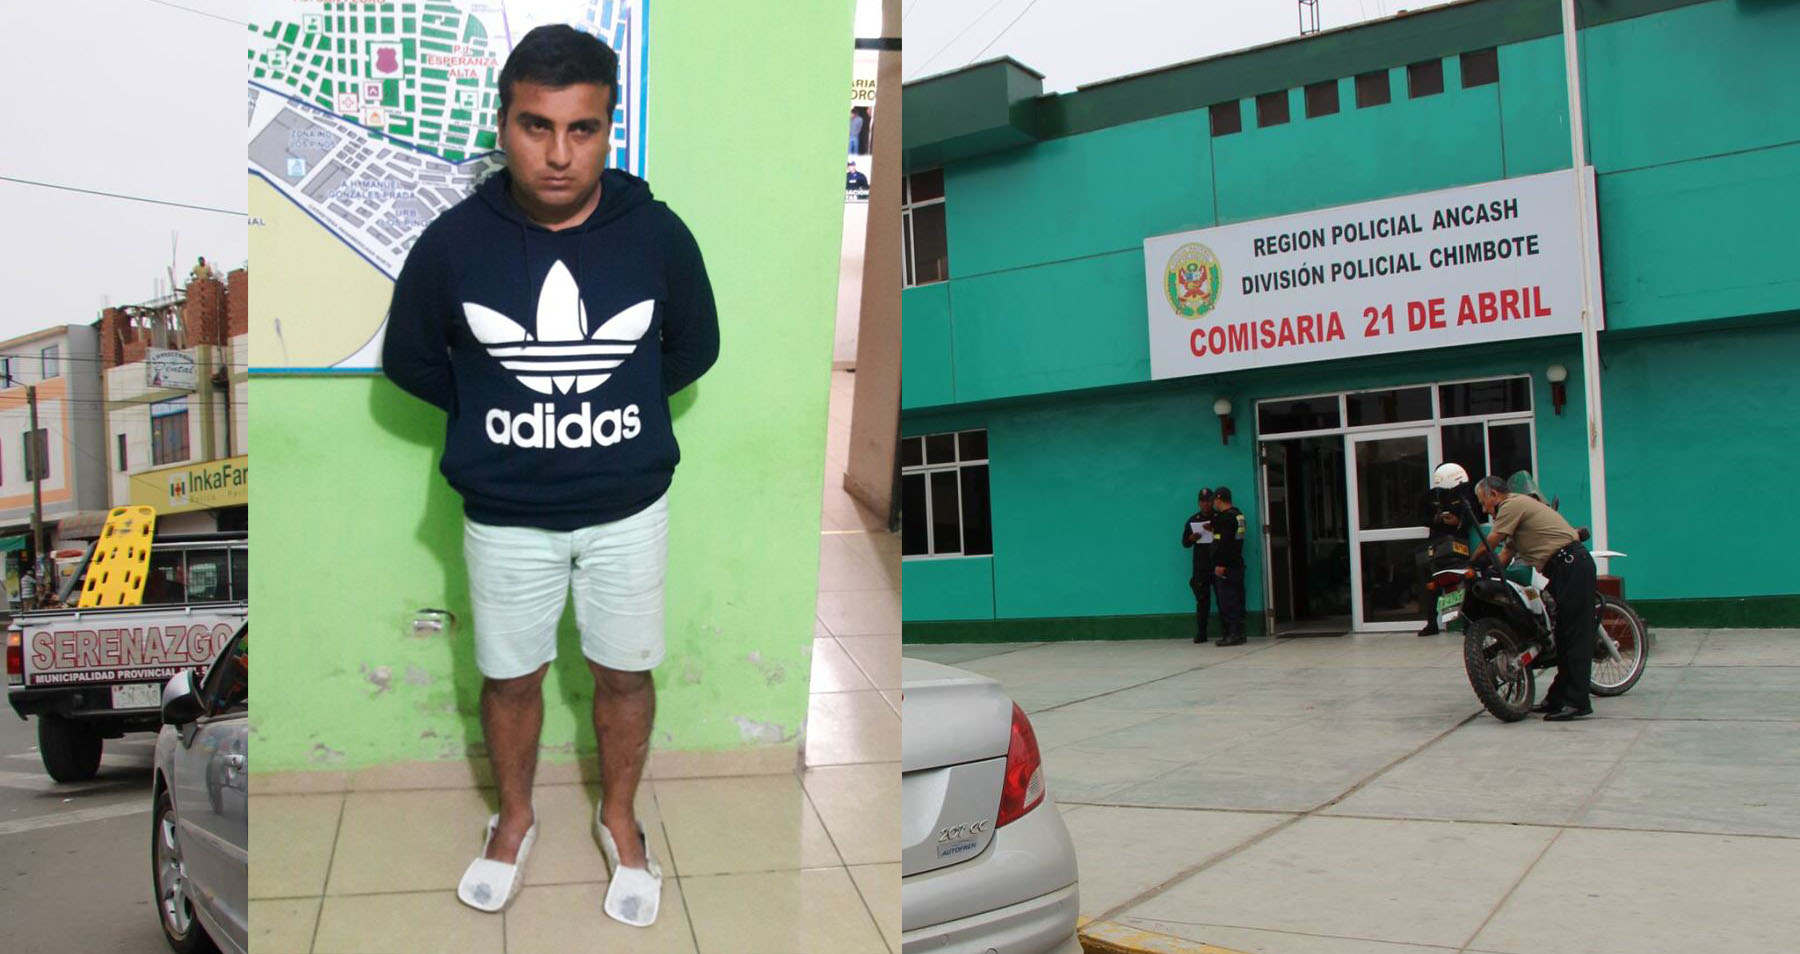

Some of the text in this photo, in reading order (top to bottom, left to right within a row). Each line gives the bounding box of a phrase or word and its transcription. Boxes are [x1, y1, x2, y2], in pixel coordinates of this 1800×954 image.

[428, 55, 498, 66] ESPERANZA
[449, 68, 478, 78] ALTA
[1253, 228, 1325, 257] REGION
[1331, 214, 1422, 245] POLICIAL
[1433, 198, 1518, 231] ANCASH
[1242, 234, 1539, 295] DIVISIÓN POLICIAL CHIMBOTE
[1190, 286, 1552, 357] COMISARIA 21 DE ABRIL
[485, 402, 641, 448] adidas
[32, 624, 233, 670] SERENAZGO
[36, 671, 115, 684] MUNICIPALIDAD
[117, 667, 176, 680] PROVINCIAL
